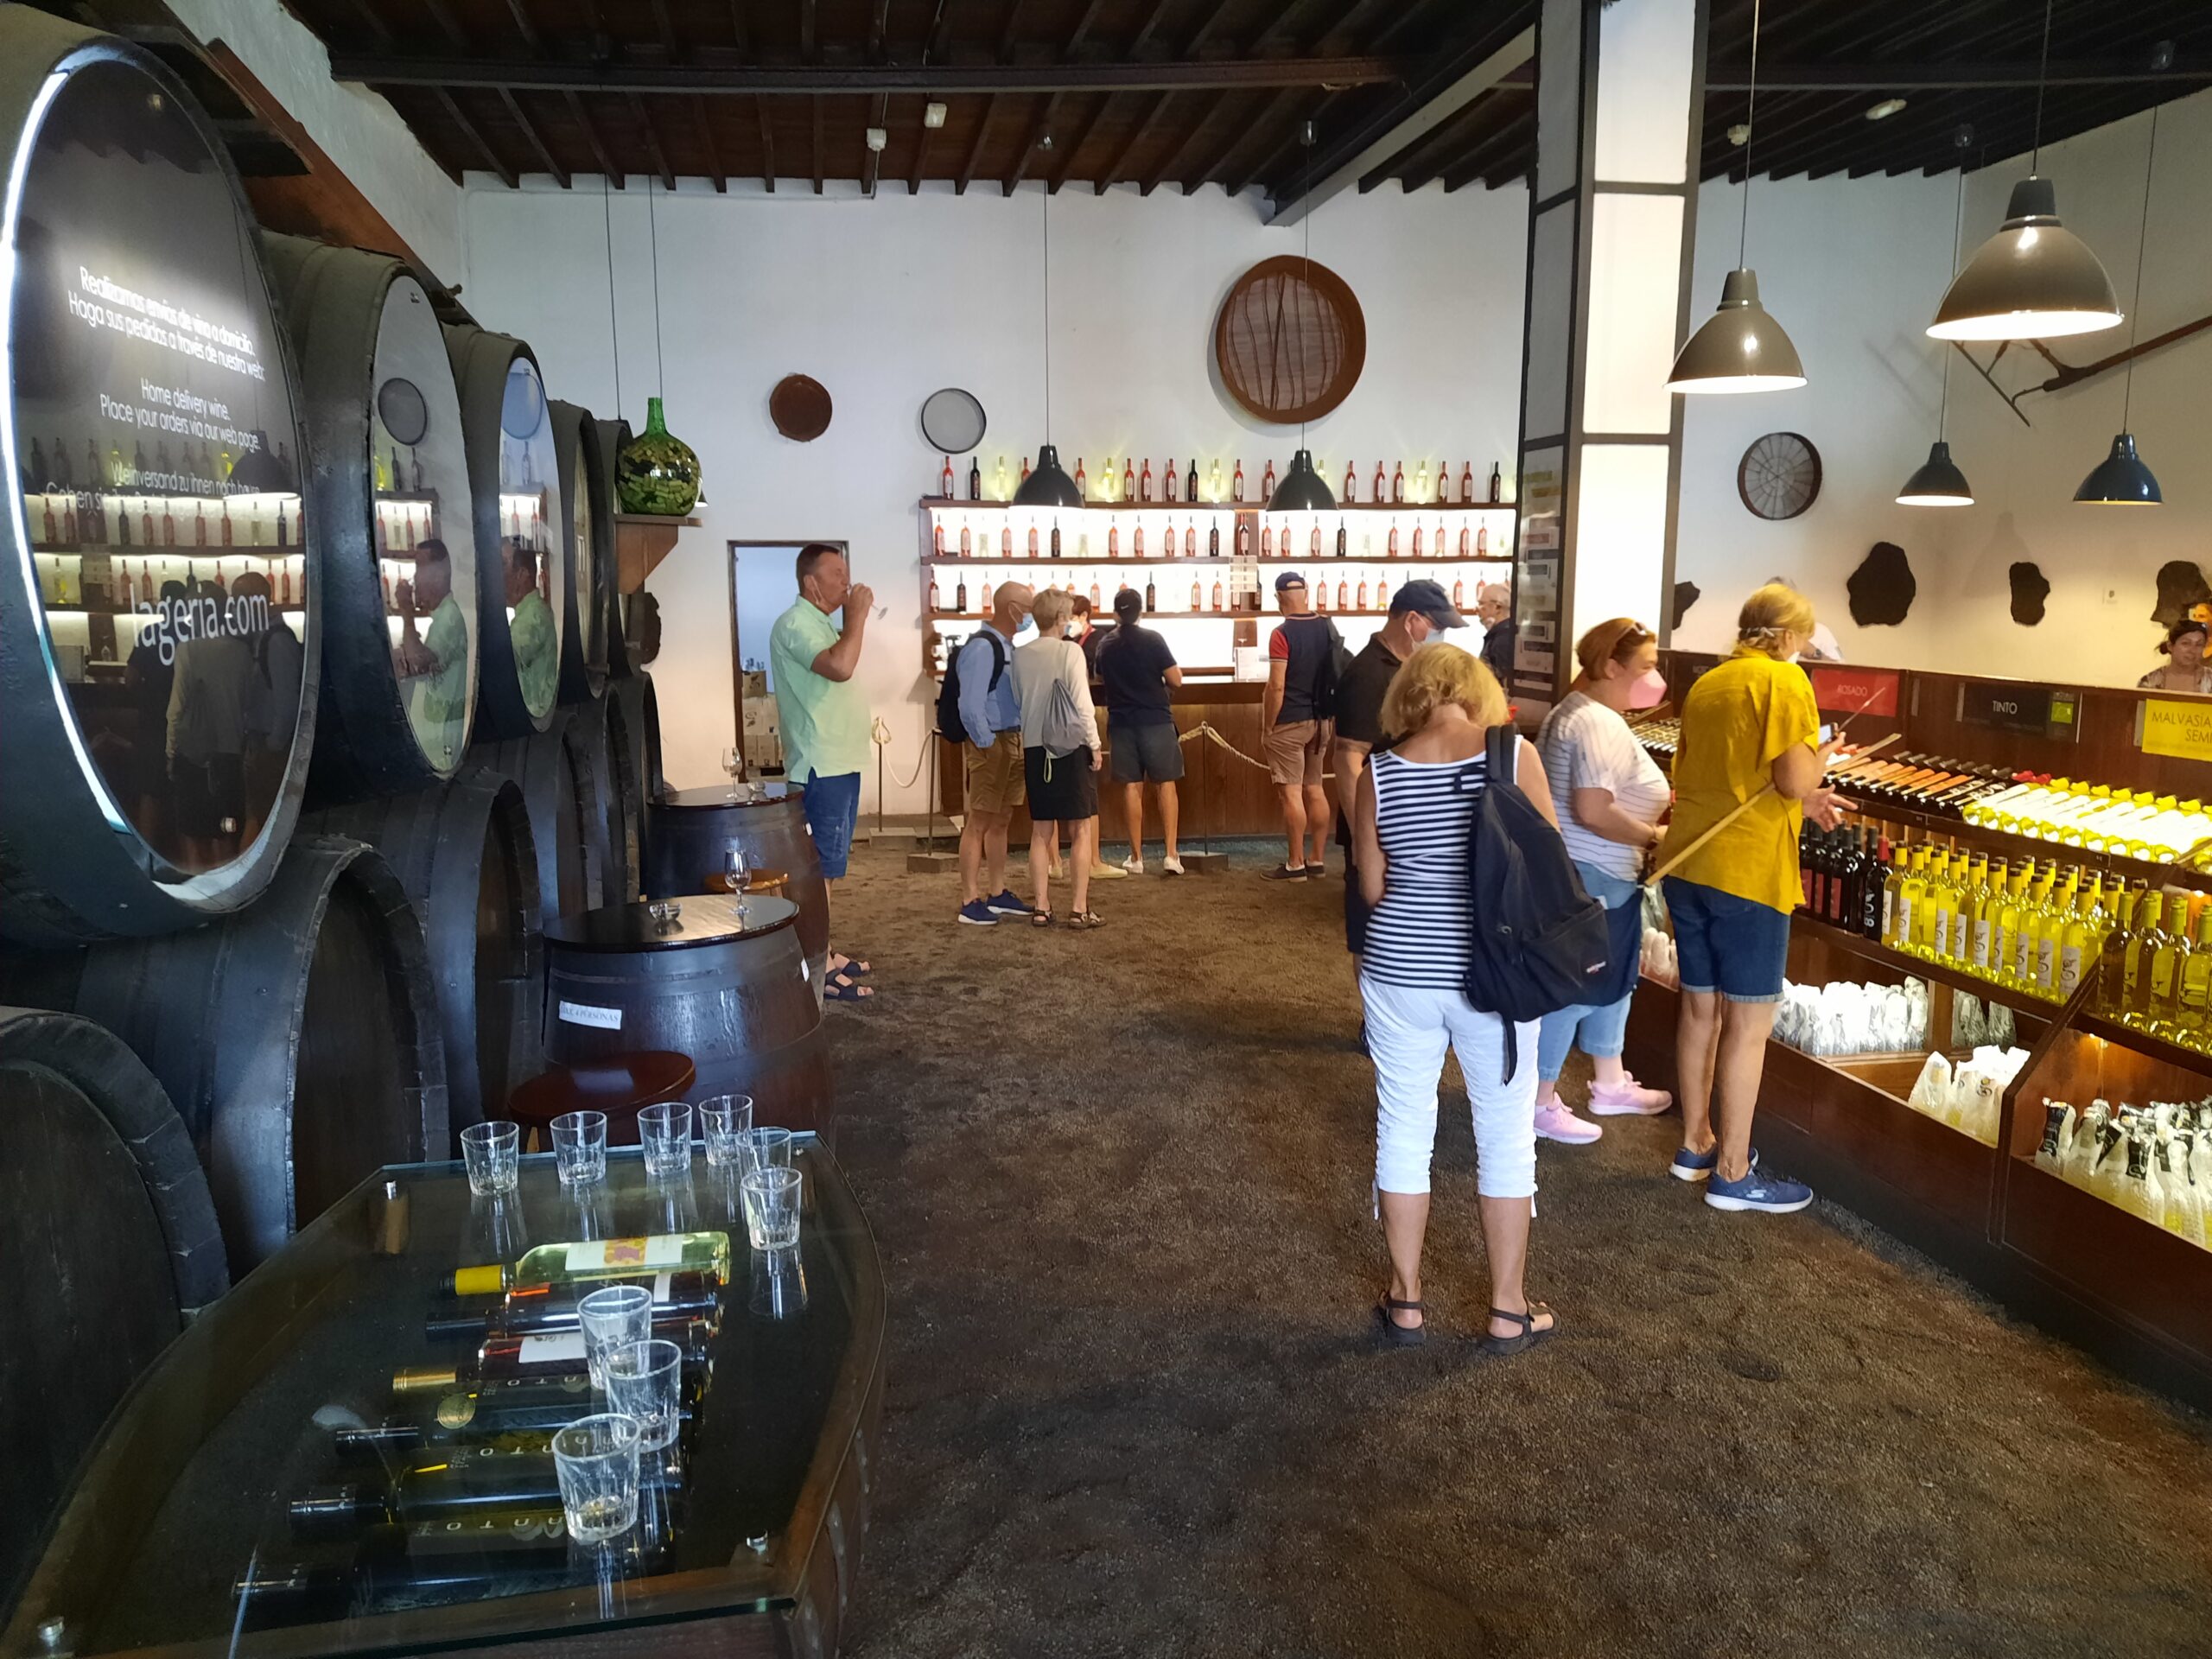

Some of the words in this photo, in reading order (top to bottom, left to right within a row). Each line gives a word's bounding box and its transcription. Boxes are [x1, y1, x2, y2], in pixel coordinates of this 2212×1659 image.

[79, 266, 145, 314] Realizamos
[177, 307, 192, 332] de
[67, 289, 105, 328] Haga
[105, 310, 125, 332] sus
[124, 315, 168, 346] pedidos
[168, 331, 177, 350] a
[177, 332, 205, 360] través
[205, 342, 218, 364] de
[217, 349, 246, 374] nuestra
[140, 377, 172, 405] Home
[173, 387, 208, 420] delivery
[207, 397, 232, 422] wine.
[99, 393, 133, 423] Place
[134, 406, 158, 429] your
[159, 410, 189, 435] orders
[189, 416, 204, 438] via
[203, 422, 219, 441] our
[218, 424, 238, 445] web
[237, 430, 262, 454] page.
[178, 475, 190, 493] zu
[190, 472, 215, 495] ihnen
[215, 478, 236, 496] nach
[1992, 700, 2018, 715] TINTO
[2151, 712, 2212, 729] MALVASÍA
